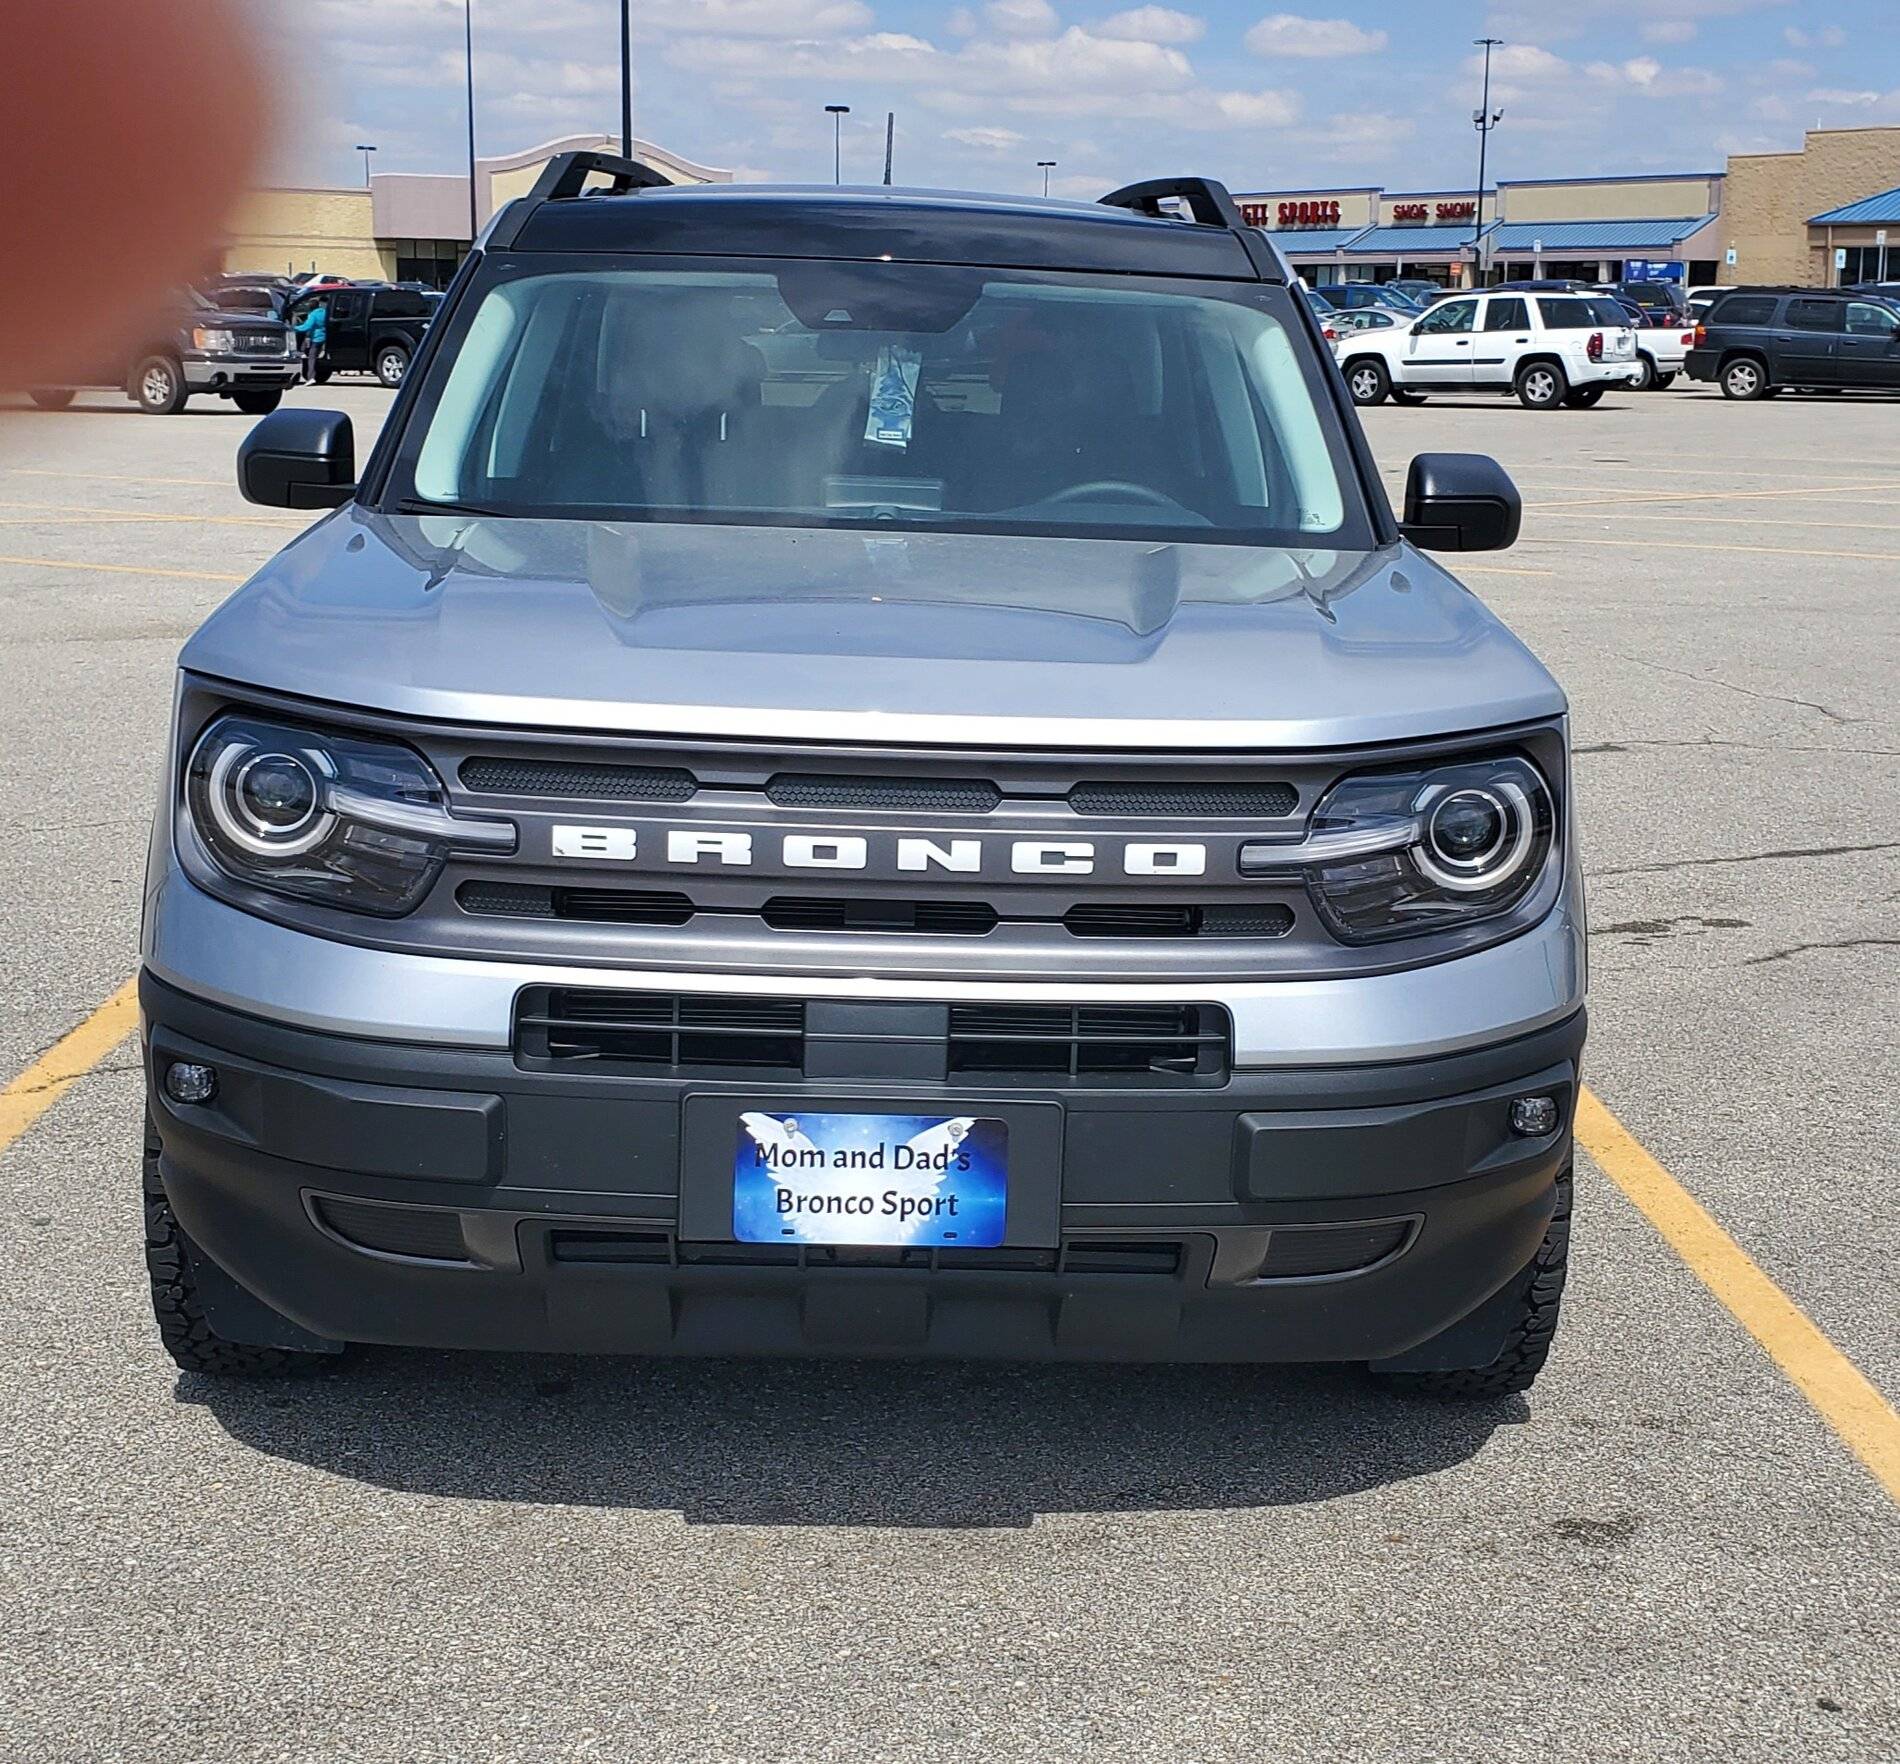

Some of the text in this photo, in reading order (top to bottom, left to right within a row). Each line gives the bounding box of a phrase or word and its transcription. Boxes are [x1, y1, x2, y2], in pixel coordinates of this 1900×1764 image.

[1235, 201, 1341, 226] ETT SPORTS
[1393, 202, 1476, 220] SHOE SHOW
[552, 825, 1207, 875] BRONCO
[755, 1142, 971, 1171] Mom and Dad's
[776, 1189, 959, 1221] Bronco Sport
